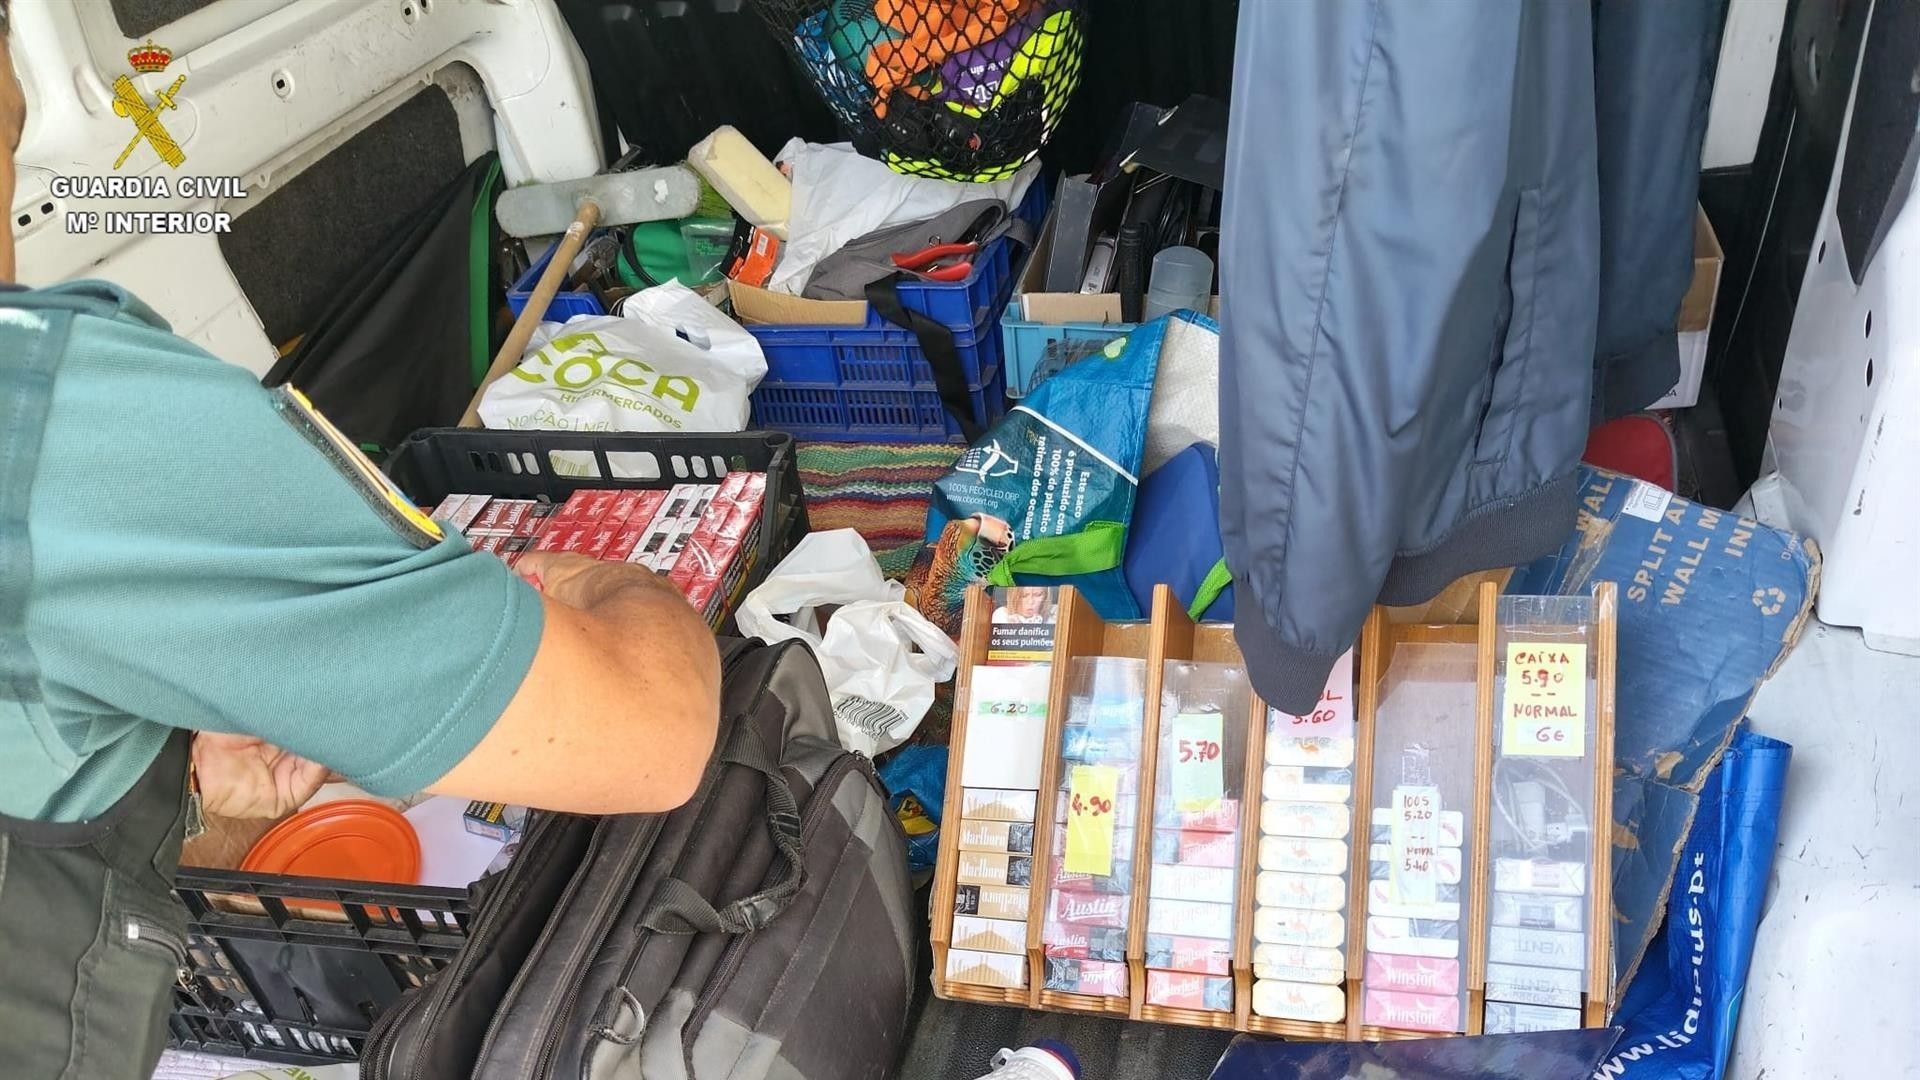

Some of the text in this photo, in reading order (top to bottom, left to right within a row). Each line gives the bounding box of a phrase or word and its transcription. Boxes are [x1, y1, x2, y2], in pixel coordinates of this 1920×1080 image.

[507, 409, 569, 430] MOÇÃO
[1022, 436, 1046, 540] retirado dos oceanos
[1040, 448, 1062, 533] 100% de plástico
[1059, 458, 1074, 512] produzido
[1074, 471, 1090, 518] Este saco
[1056, 512, 1065, 535] com
[1626, 527, 1673, 603] SPLIT
[1661, 537, 1710, 605] WALL
[992, 626, 1050, 636] Fumar danifica
[1020, 637, 1054, 647] pulmões
[1522, 669, 1564, 687] 5.90
[990, 703, 1029, 713] 6.20
[1513, 703, 1577, 718] NORMAL
[1179, 739, 1221, 763] 5.70
[1071, 793, 1112, 816] 4.90
[1404, 810, 1433, 821] 5.20
[1060, 898, 1117, 919] Austin
[1388, 966, 1436, 988] Winston
[1388, 1007, 1436, 1026] Winston
